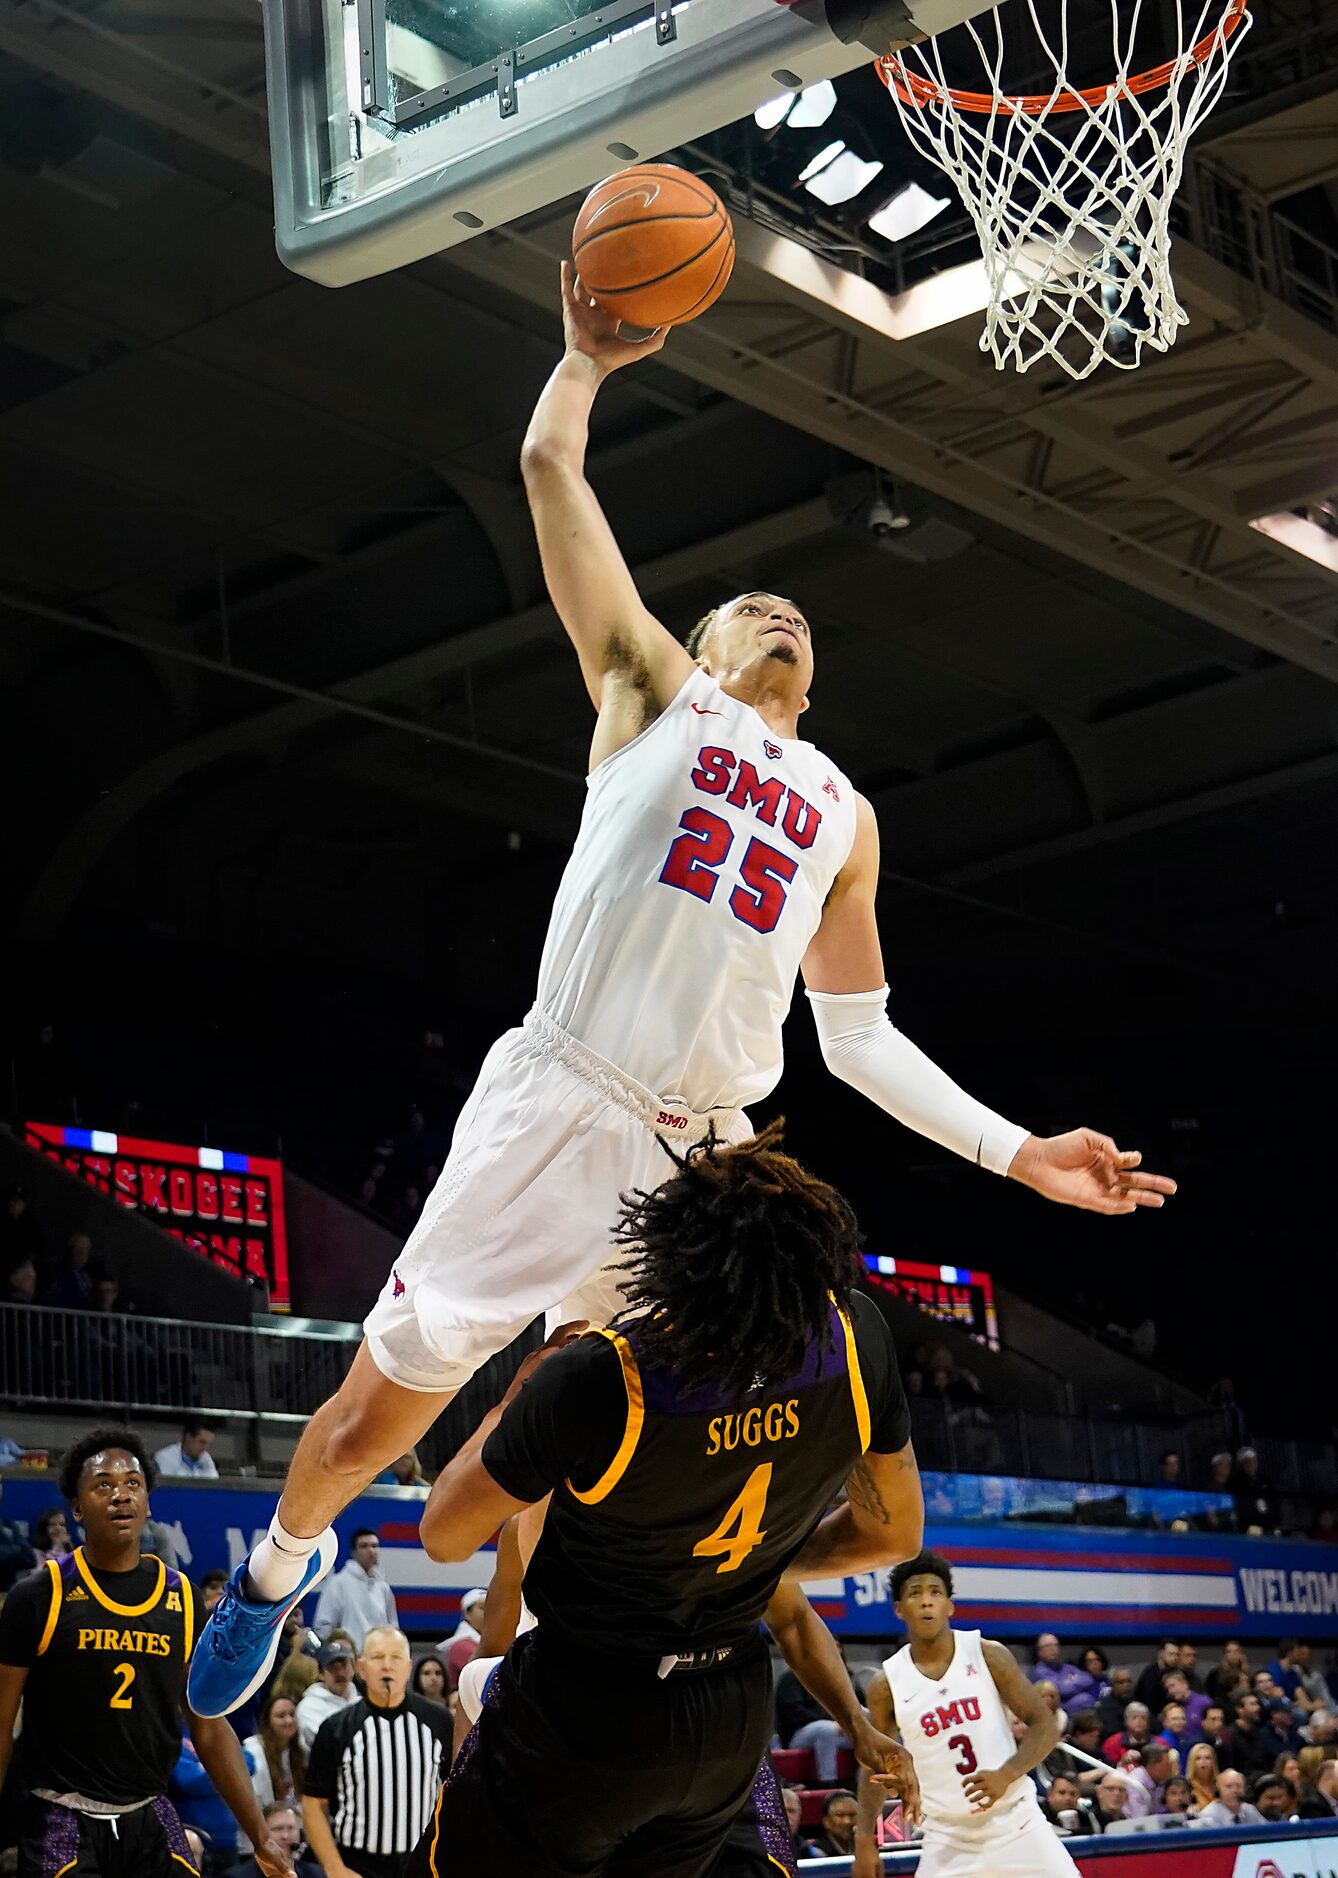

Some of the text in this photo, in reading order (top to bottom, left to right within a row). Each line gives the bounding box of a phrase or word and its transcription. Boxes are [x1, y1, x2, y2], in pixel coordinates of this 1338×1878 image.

[690, 745, 823, 850] SMU
[657, 805, 800, 935] 25
[706, 1399, 800, 1456] SUGGS
[692, 1461, 773, 1575] 4
[77, 1628, 171, 1657] PIRATES
[109, 1662, 136, 1709] 2
[920, 1696, 981, 1738] SMU
[948, 1733, 978, 1776] 3
